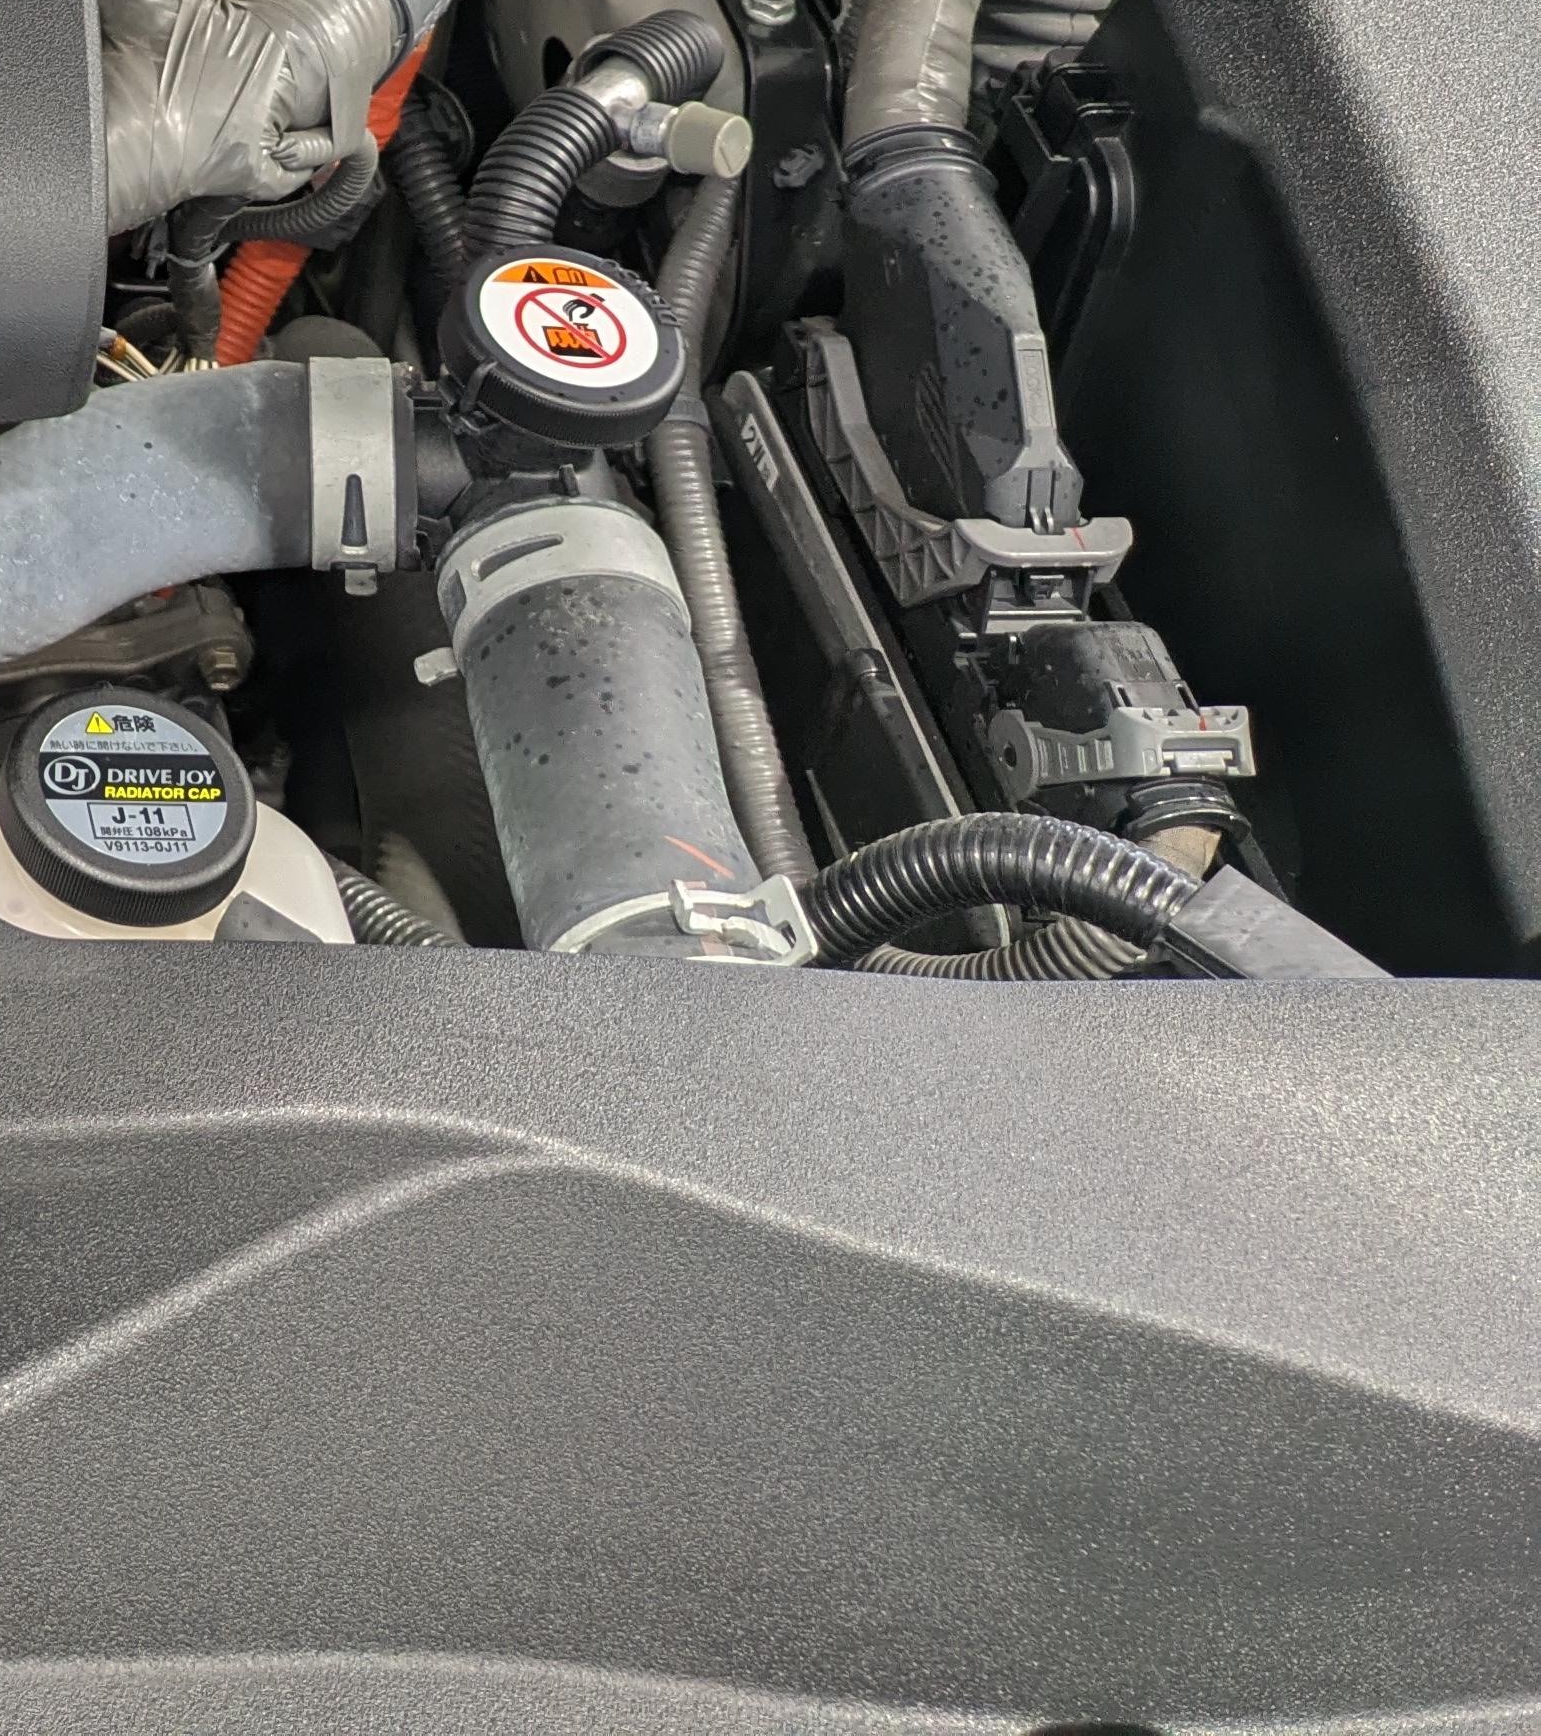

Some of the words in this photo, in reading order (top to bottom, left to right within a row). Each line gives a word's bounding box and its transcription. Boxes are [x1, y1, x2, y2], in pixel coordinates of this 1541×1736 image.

[112, 715, 156, 733] 危険
[54, 762, 90, 791] DJ
[107, 768, 172, 785] DRIVE
[175, 769, 216, 786] JOY
[104, 785, 185, 800] RADIATOR
[188, 787, 221, 800] CAP
[111, 807, 165, 825] J-11
[136, 826, 188, 838] 108kPa
